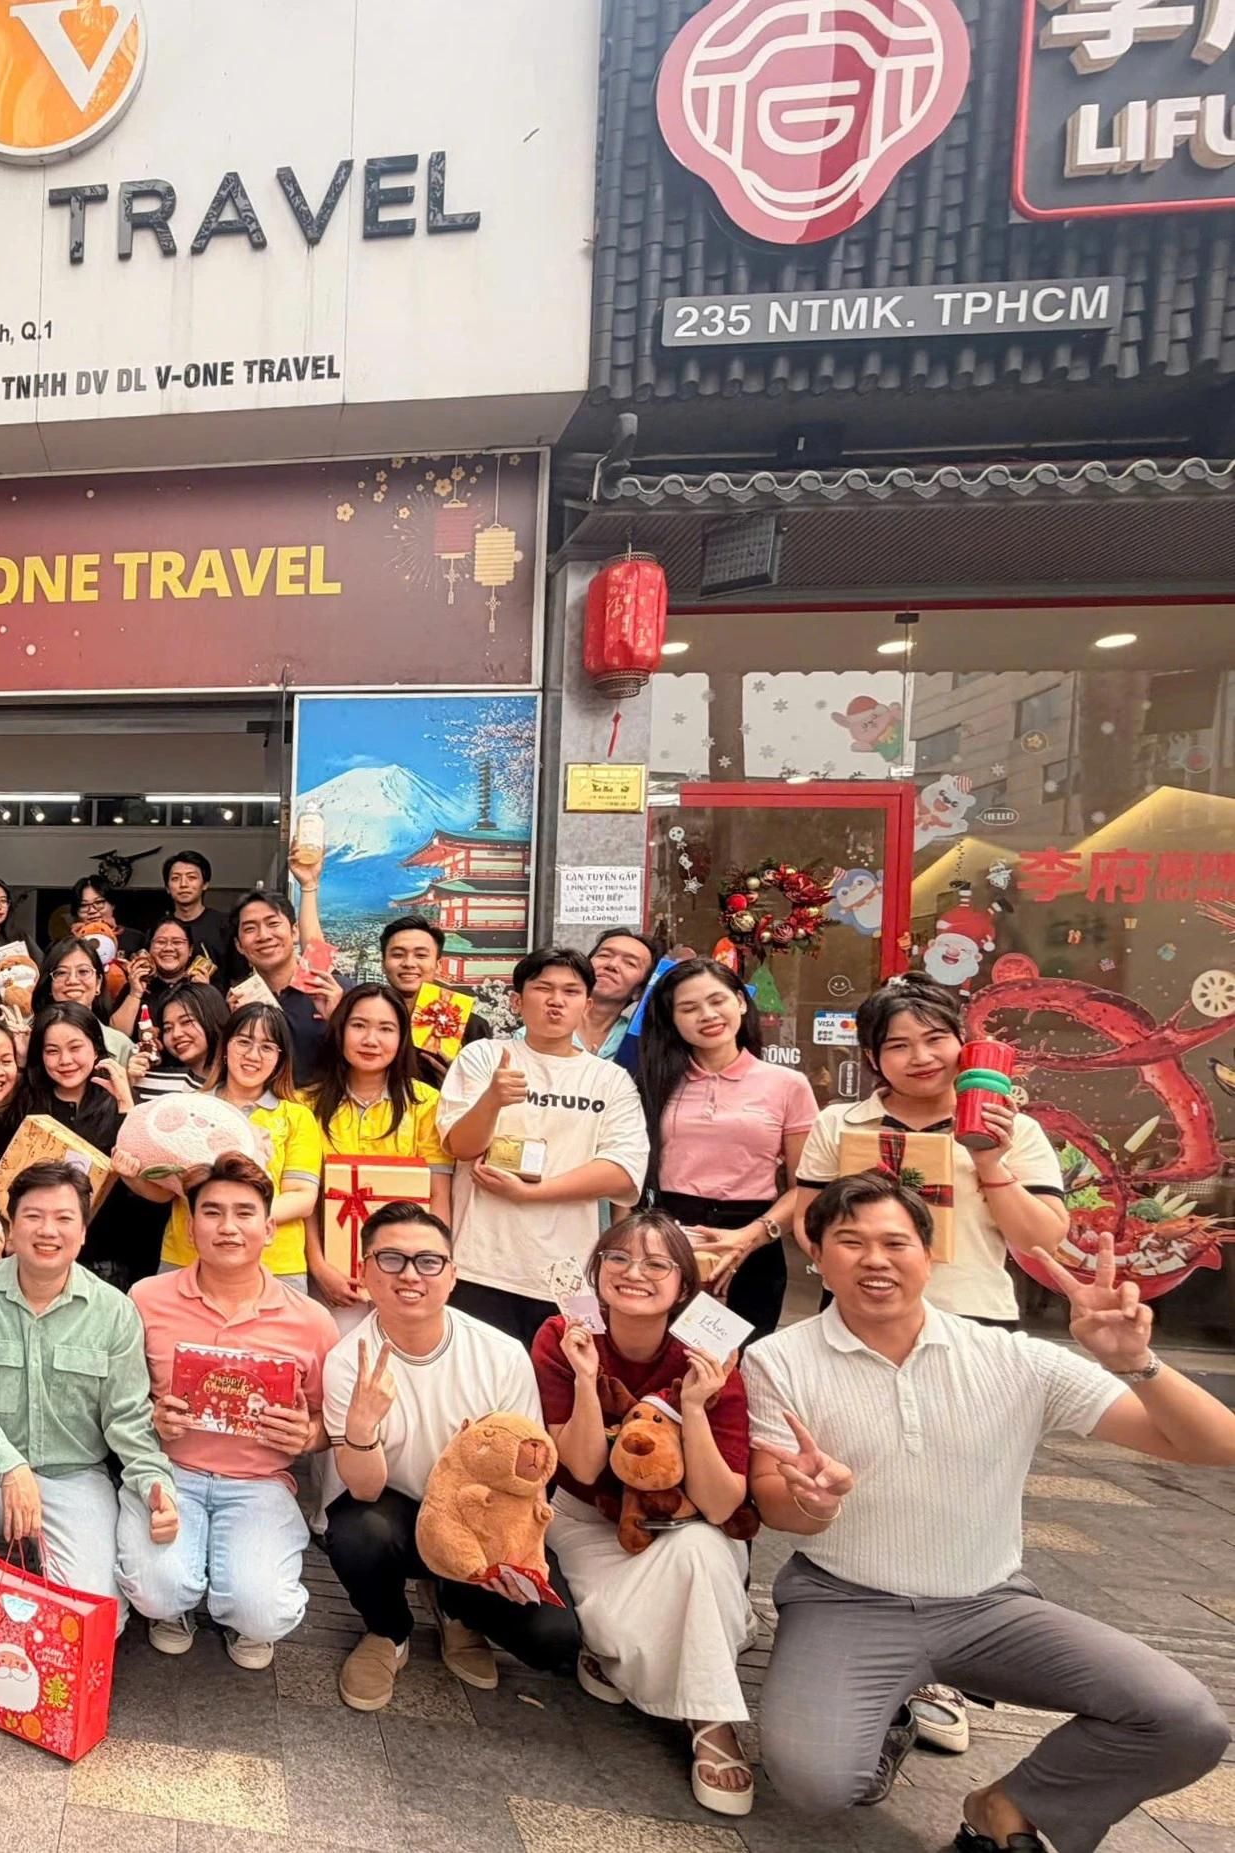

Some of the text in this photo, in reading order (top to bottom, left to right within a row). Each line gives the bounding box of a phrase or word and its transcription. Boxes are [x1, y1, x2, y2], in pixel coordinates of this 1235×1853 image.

[48, 151, 480, 264] TRAVEL
[21, 320, 52, 340] Q.1
[674, 285, 1110, 339] 235 NTMK. TPHCM
[2, 372, 67, 400] TNHH
[76, 369, 108, 395] DV
[117, 367, 146, 393] DL
[155, 361, 234, 390] V-ONE
[243, 355, 340, 384] TRAVEL
[113, 545, 342, 601] TRAVEL
[1017, 847, 1154, 903] 李府
